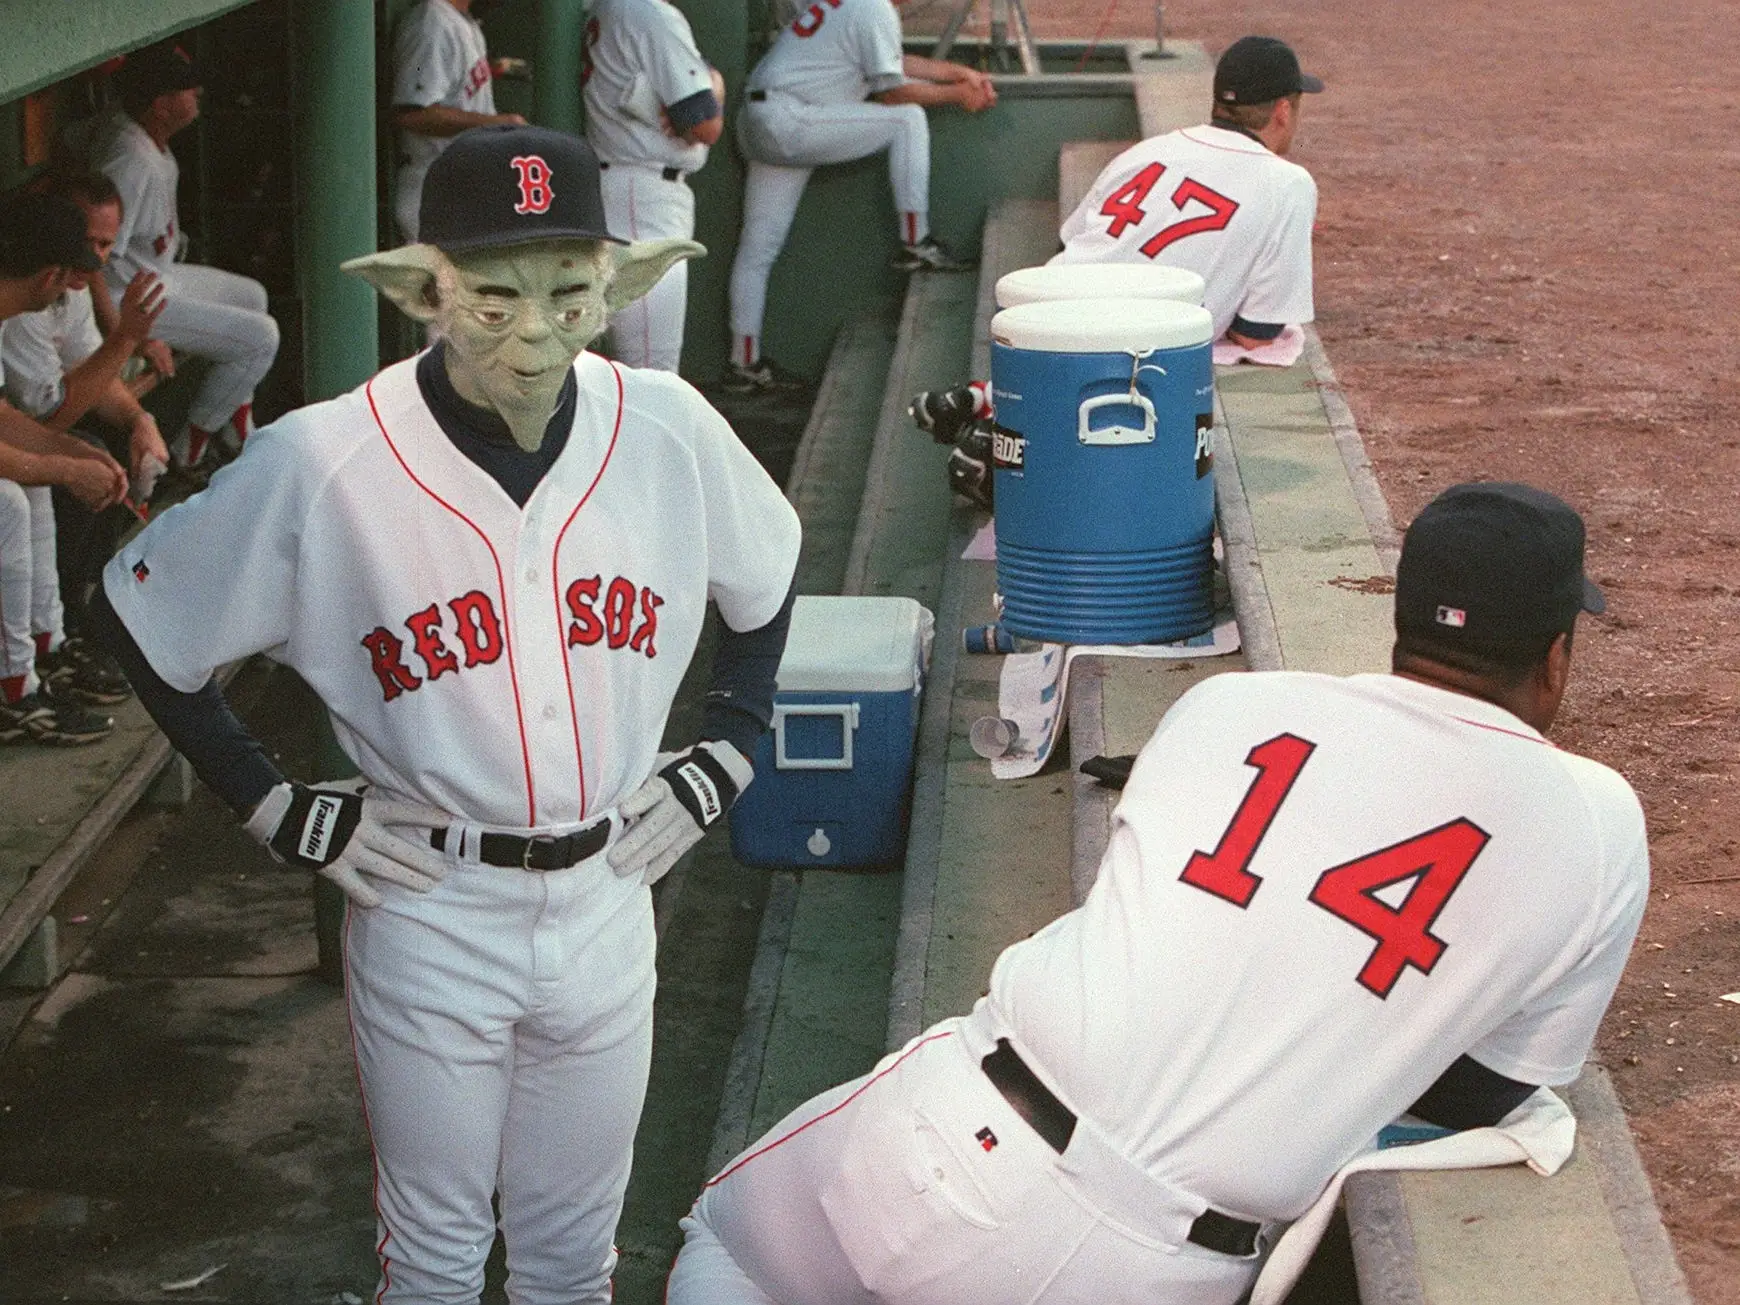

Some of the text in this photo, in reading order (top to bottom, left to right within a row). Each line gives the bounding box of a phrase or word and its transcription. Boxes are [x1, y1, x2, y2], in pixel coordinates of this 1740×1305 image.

[510, 155, 555, 214] B
[1099, 161, 1240, 260] 47
[361, 574, 665, 702] RED SOX
[305, 797, 336, 858] Franklin
[685, 766, 718, 816] Franklin
[1177, 731, 1493, 1001] 14
